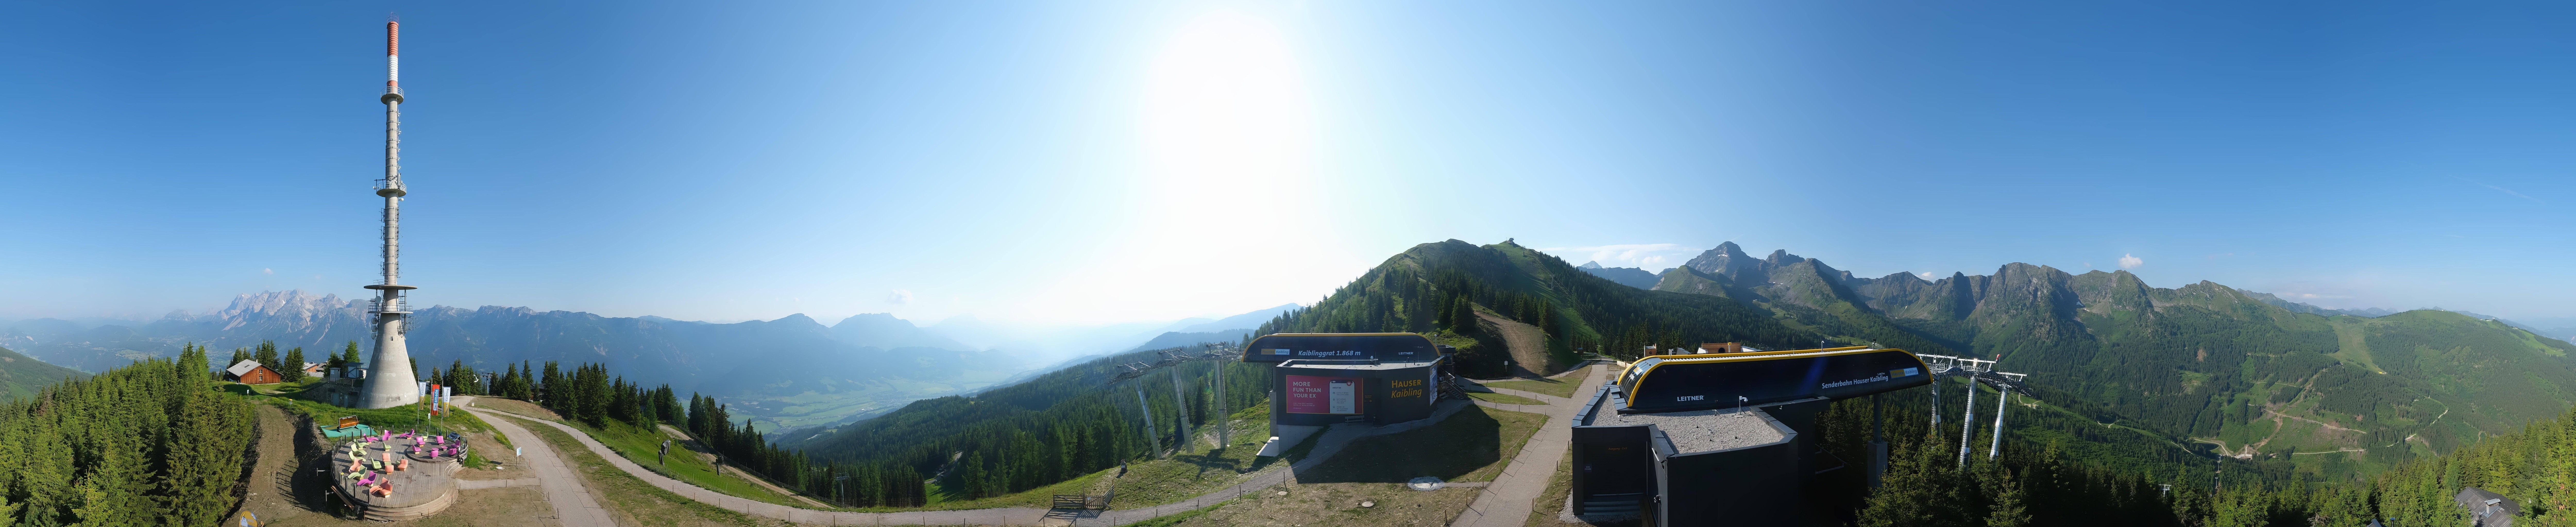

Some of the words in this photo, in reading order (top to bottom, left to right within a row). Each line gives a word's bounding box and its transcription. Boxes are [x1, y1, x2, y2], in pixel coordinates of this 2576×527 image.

[1392, 379, 1421, 388] HAUSER
[1822, 380, 1852, 389] Senderbahn
[1391, 388, 1422, 398] Kaibling
